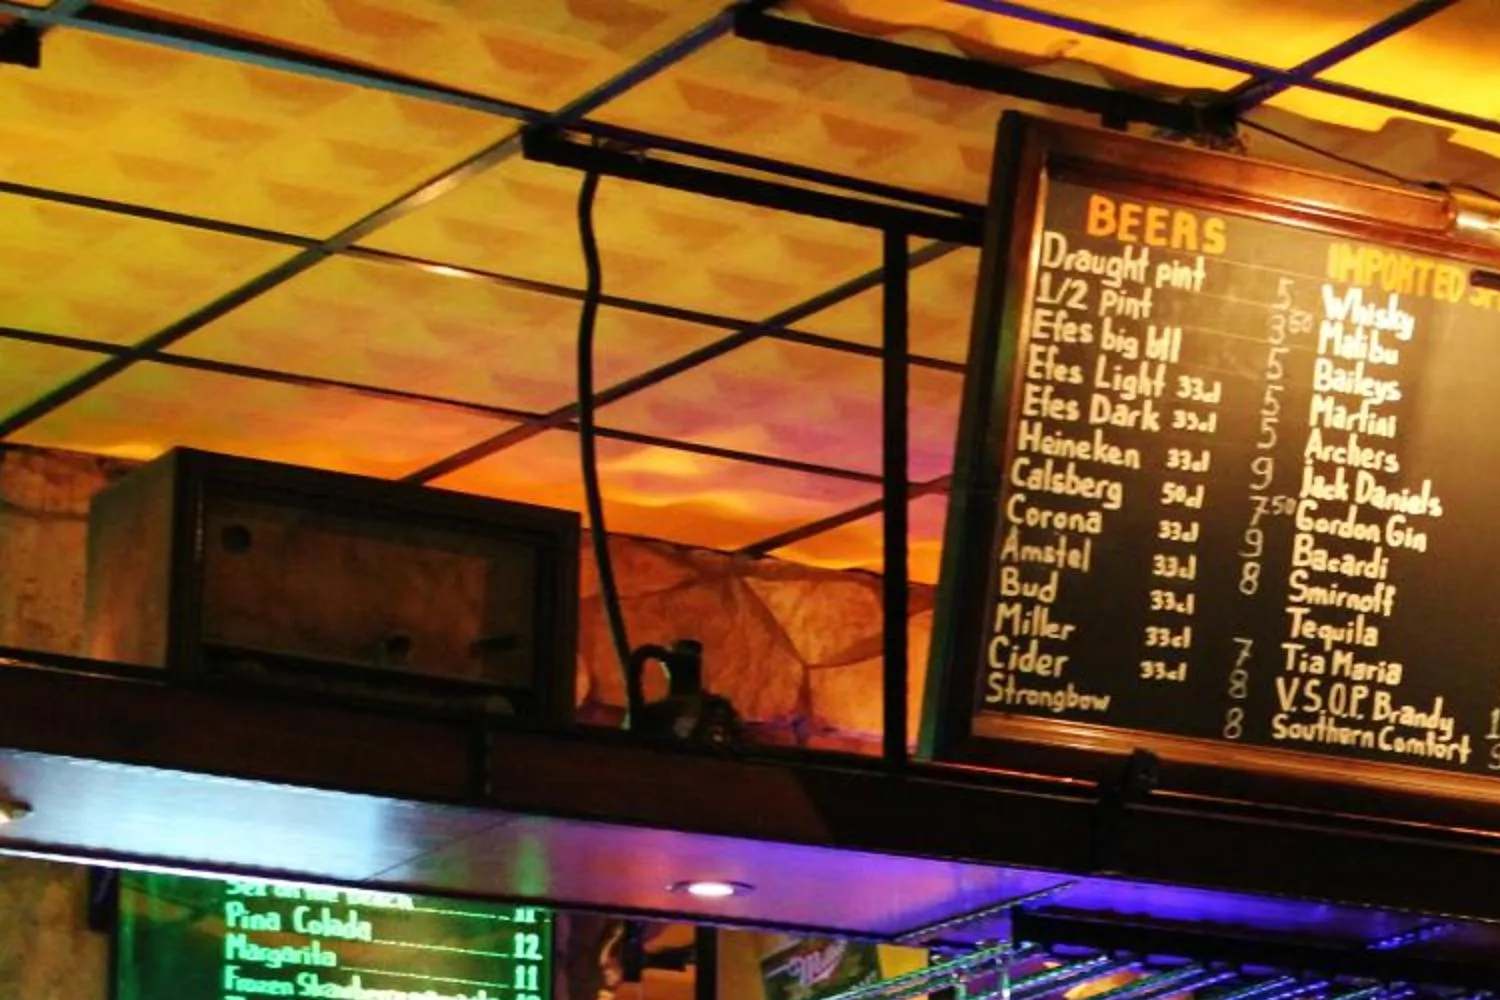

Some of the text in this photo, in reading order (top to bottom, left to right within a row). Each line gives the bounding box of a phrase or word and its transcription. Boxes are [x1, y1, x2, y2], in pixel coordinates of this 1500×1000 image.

[1087, 194, 1227, 254] BEERS
[1040, 231, 1149, 287] Draught
[1327, 243, 1465, 303] IMPORTED
[1037, 272, 1088, 310] 1/2
[1321, 284, 1415, 340] Whisky
[1032, 309, 1093, 344] Efes
[1101, 317, 1138, 359] big
[1318, 320, 1399, 365] Malibu
[1028, 343, 1221, 403] Efes Light 33cl
[1313, 357, 1402, 406] Baileys
[1023, 382, 1159, 432] Efes Dark
[1309, 394, 1396, 438] Martini
[1018, 420, 1273, 490] Heineken 9
[1304, 428, 1400, 473] Archers
[1011, 457, 1123, 509] Calsberg
[1355, 470, 1443, 517] Daniels
[1007, 494, 1198, 542] Corona 33cl
[1295, 499, 1427, 553] Gordon Gin
[1001, 524, 1260, 595] Amstel 8
[1292, 533, 1389, 580] Bacardi
[1001, 566, 1194, 615] Bud 33cl
[1288, 570, 1396, 617] Smirnoff
[995, 602, 1253, 668] Miller 7
[1285, 607, 1379, 650] Tequila
[989, 636, 1187, 682] Cider 33cl
[1281, 643, 1402, 685] Tia Maria
[985, 672, 1111, 712] Strongbow
[1373, 692, 1455, 741] Brandy
[1272, 712, 1373, 749] Southern
[1378, 727, 1471, 763] Comfort
[225, 932, 337, 968] Margarita
[293, 906, 373, 942] Colada
[513, 932, 543, 960] 12
